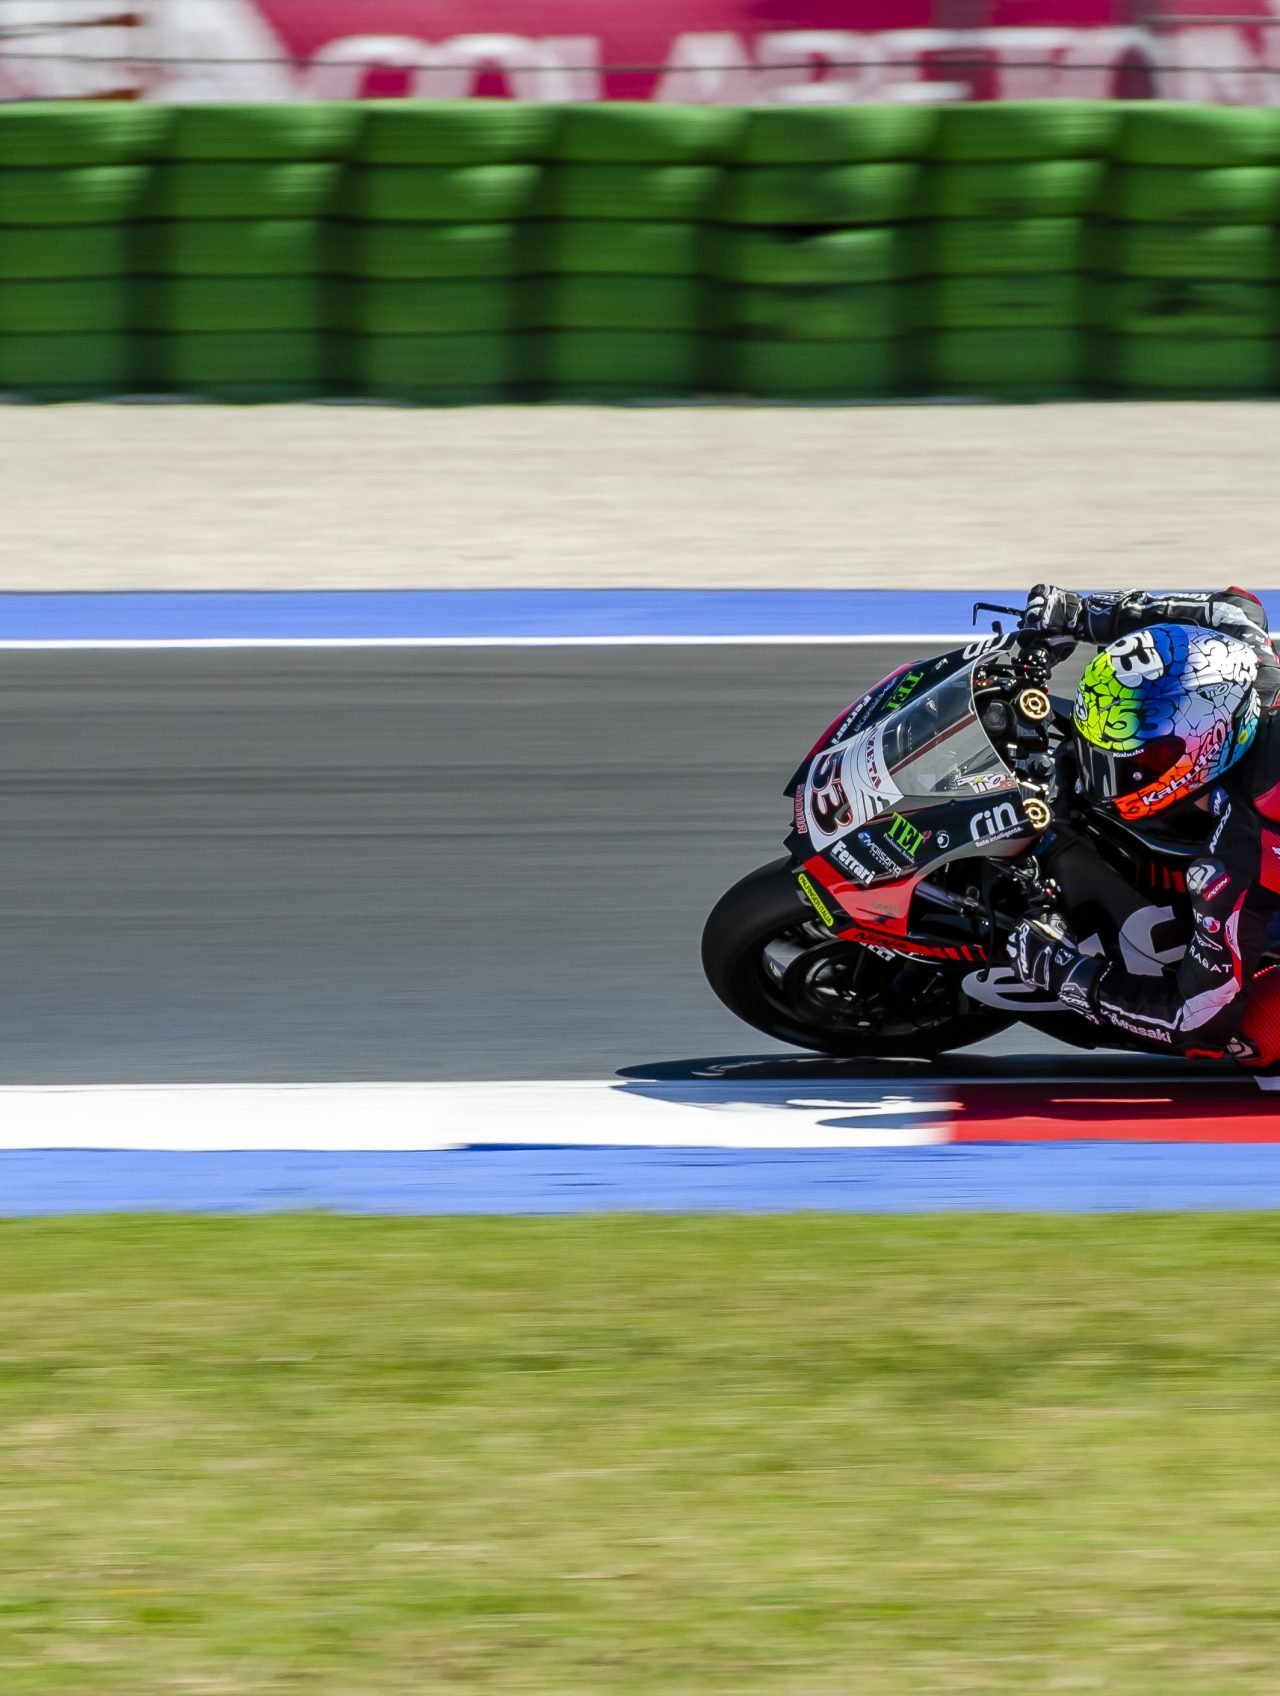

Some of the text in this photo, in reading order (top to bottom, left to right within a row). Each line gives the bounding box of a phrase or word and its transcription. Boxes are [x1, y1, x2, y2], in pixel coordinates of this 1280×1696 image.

[1103, 697, 1177, 742] 53
[811, 745, 854, 836] 53
[1142, 744, 1220, 806] Kabuto
[886, 811, 926, 856] TEI
[969, 801, 1019, 841] rin
[830, 839, 876, 886] Ferrari
[1188, 944, 1233, 974] RABAT
